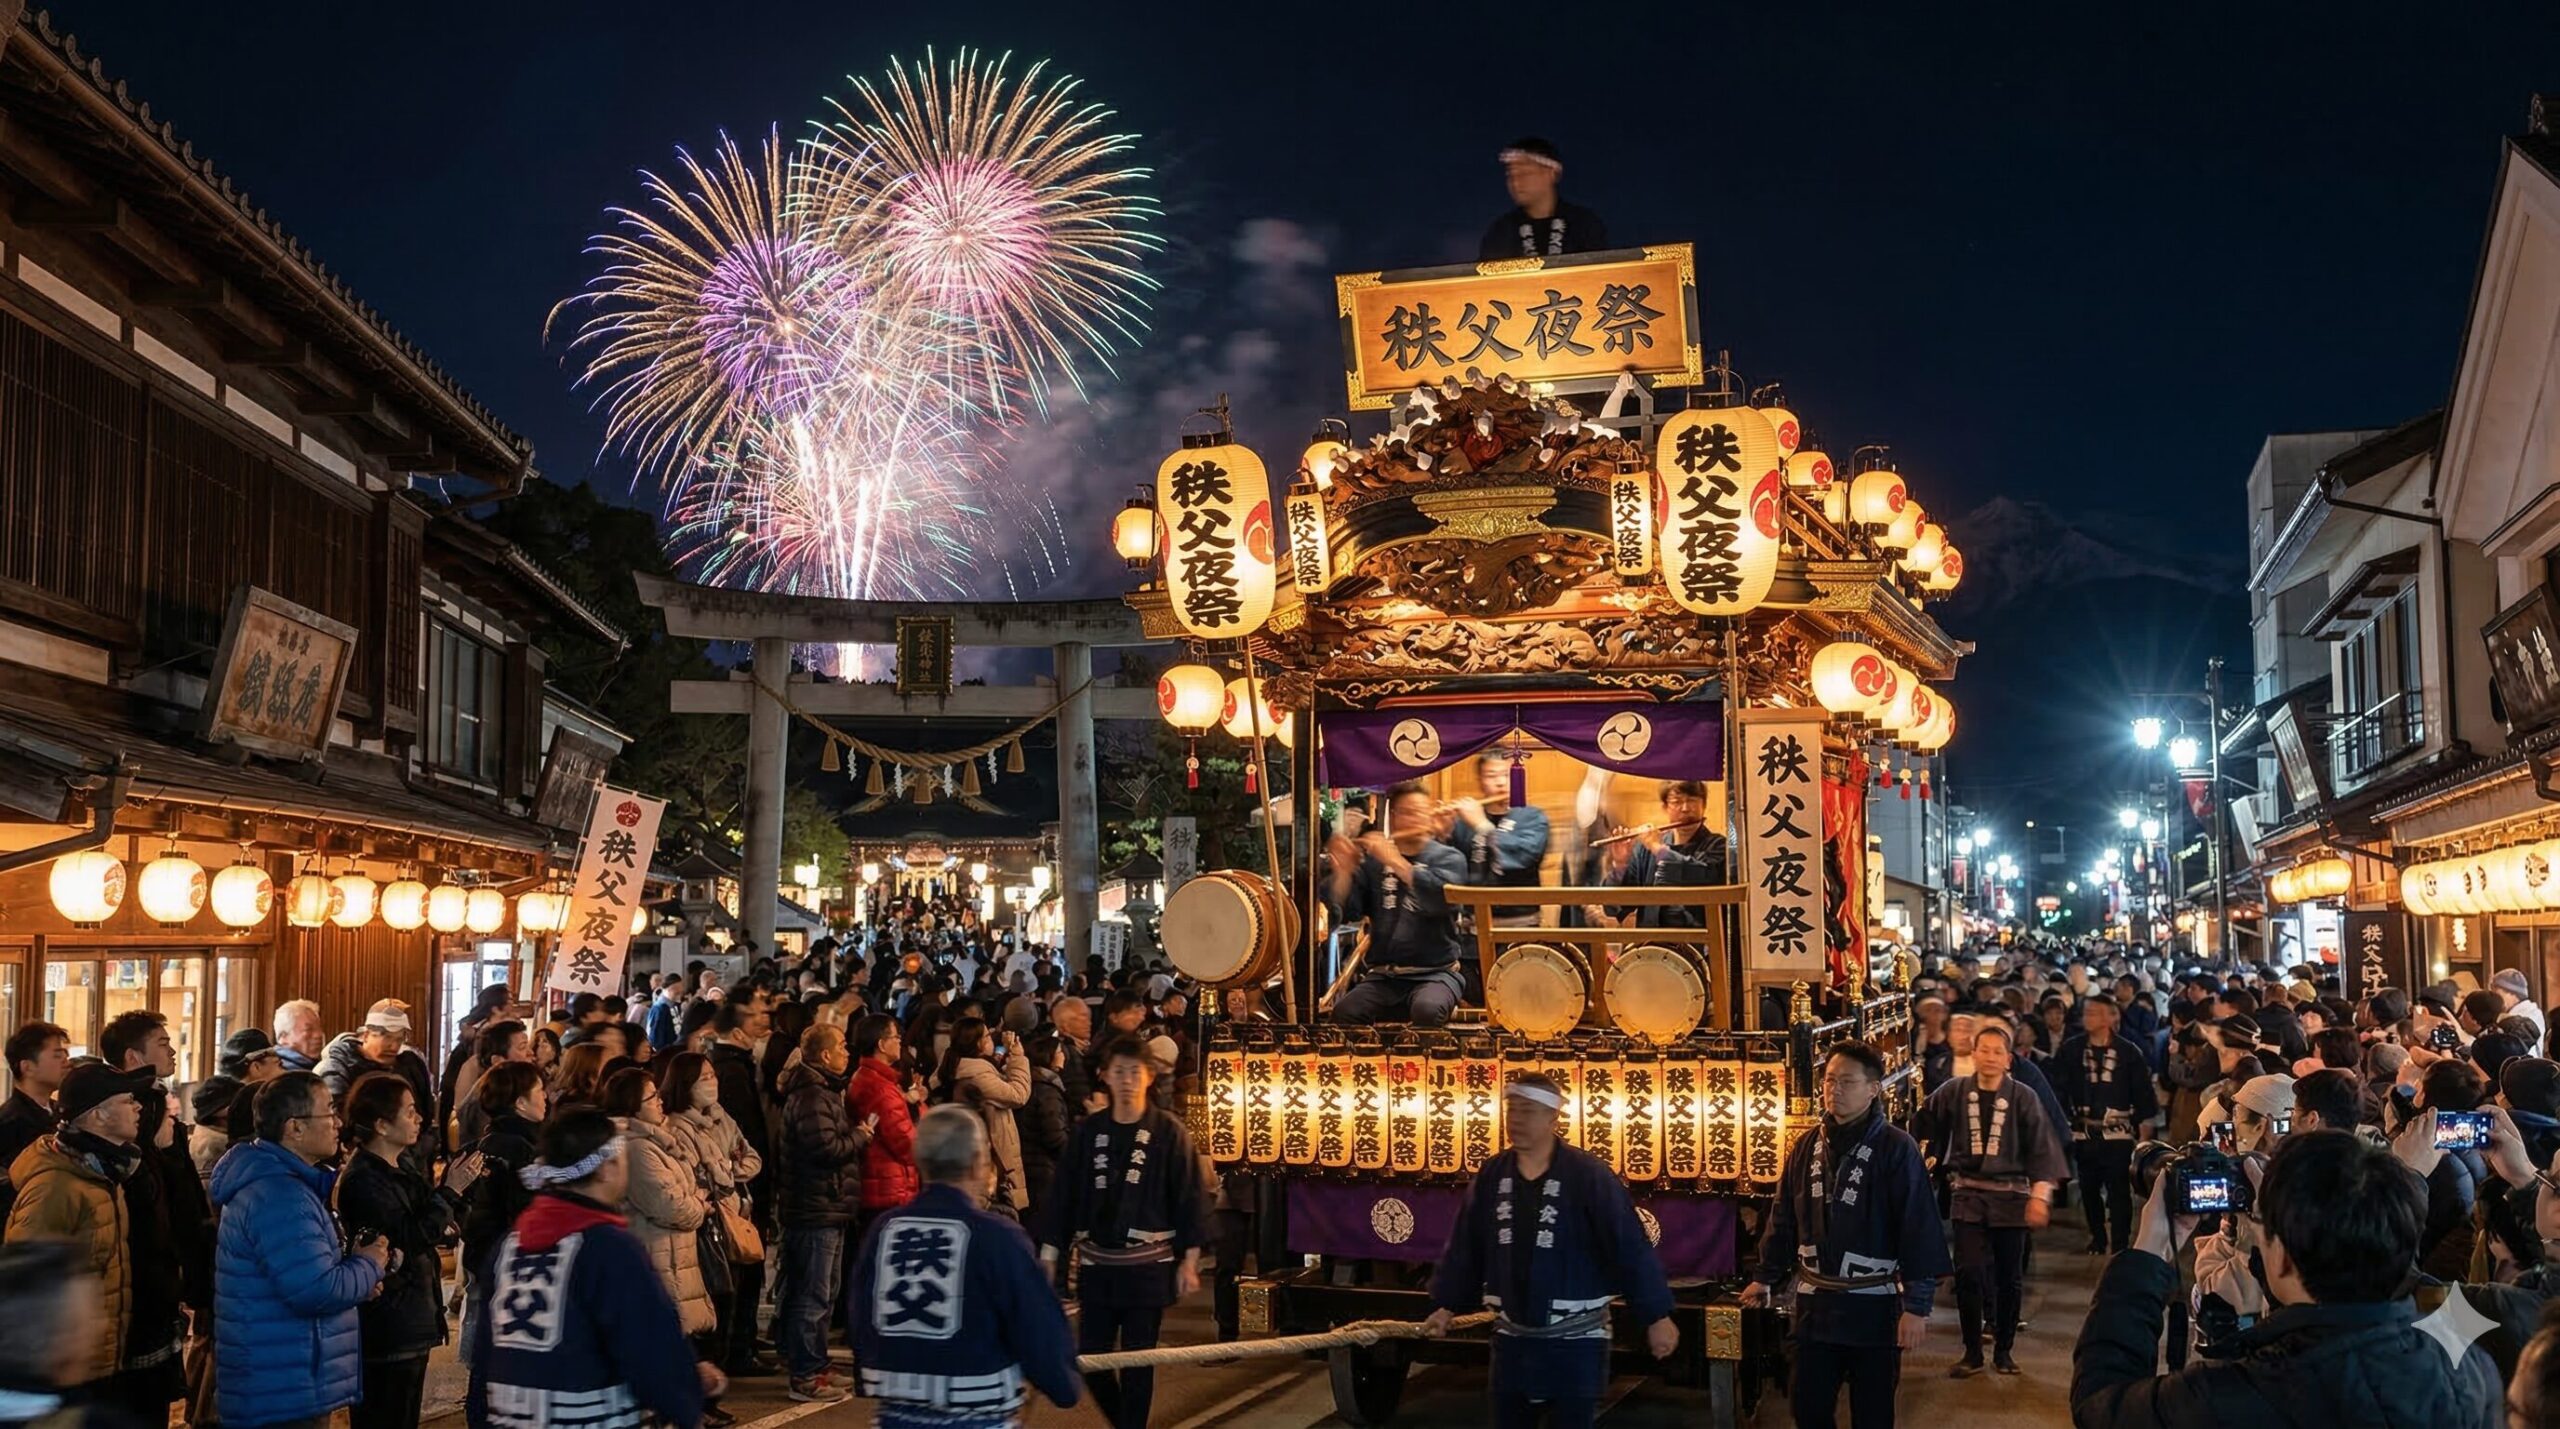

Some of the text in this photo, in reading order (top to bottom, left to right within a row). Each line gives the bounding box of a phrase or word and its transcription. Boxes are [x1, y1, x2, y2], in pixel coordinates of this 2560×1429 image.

[1381, 283, 1666, 371] 秩父夜祭
[1170, 460, 1244, 628] 秩父夜祭
[1289, 501, 1322, 587] 秩父夜祭
[1613, 480, 1643, 568] 秩父夜祭
[1674, 423, 1745, 604] 秩父夜祭
[1757, 734, 1815, 956] 秩父夜祭
[568, 829, 637, 986] 秩父夜祭
[1208, 1058, 1237, 1156] 秩父夜祭
[1246, 1059, 1274, 1157] 秩父夜祭
[1281, 1060, 1310, 1158] 秩父夜祭
[1316, 1062, 1344, 1161] 秩父夜祭
[1352, 1062, 1381, 1163] 秩父夜祭
[1624, 1069, 1654, 1174] 秩父夜祭
[1666, 1067, 1697, 1173] 秩父夜祭
[1706, 1067, 1737, 1174] 秩父夜祭
[1749, 1069, 1779, 1177] 秩父夜祭
[886, 1227, 954, 1329] 秩父
